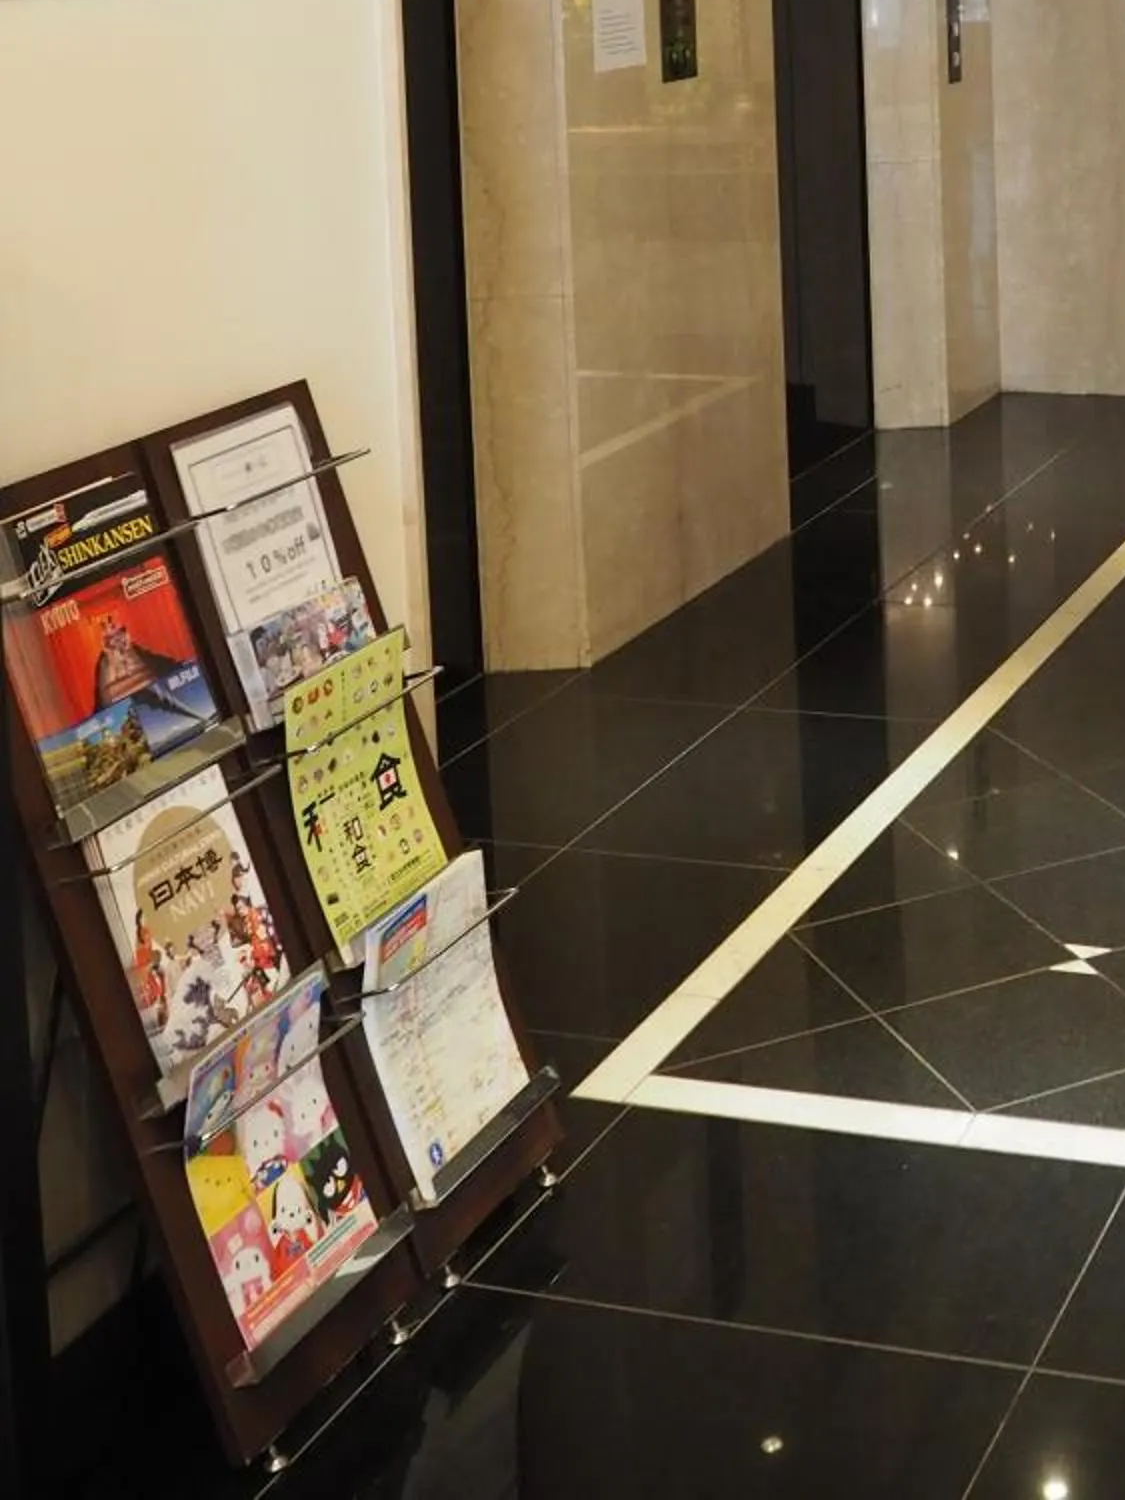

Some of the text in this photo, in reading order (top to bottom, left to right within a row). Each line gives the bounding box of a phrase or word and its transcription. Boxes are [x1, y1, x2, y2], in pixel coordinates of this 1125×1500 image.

[57, 514, 154, 570] SHINKANSEN
[148, 848, 224, 911] 日本博
[168, 878, 216, 922] NAVI
